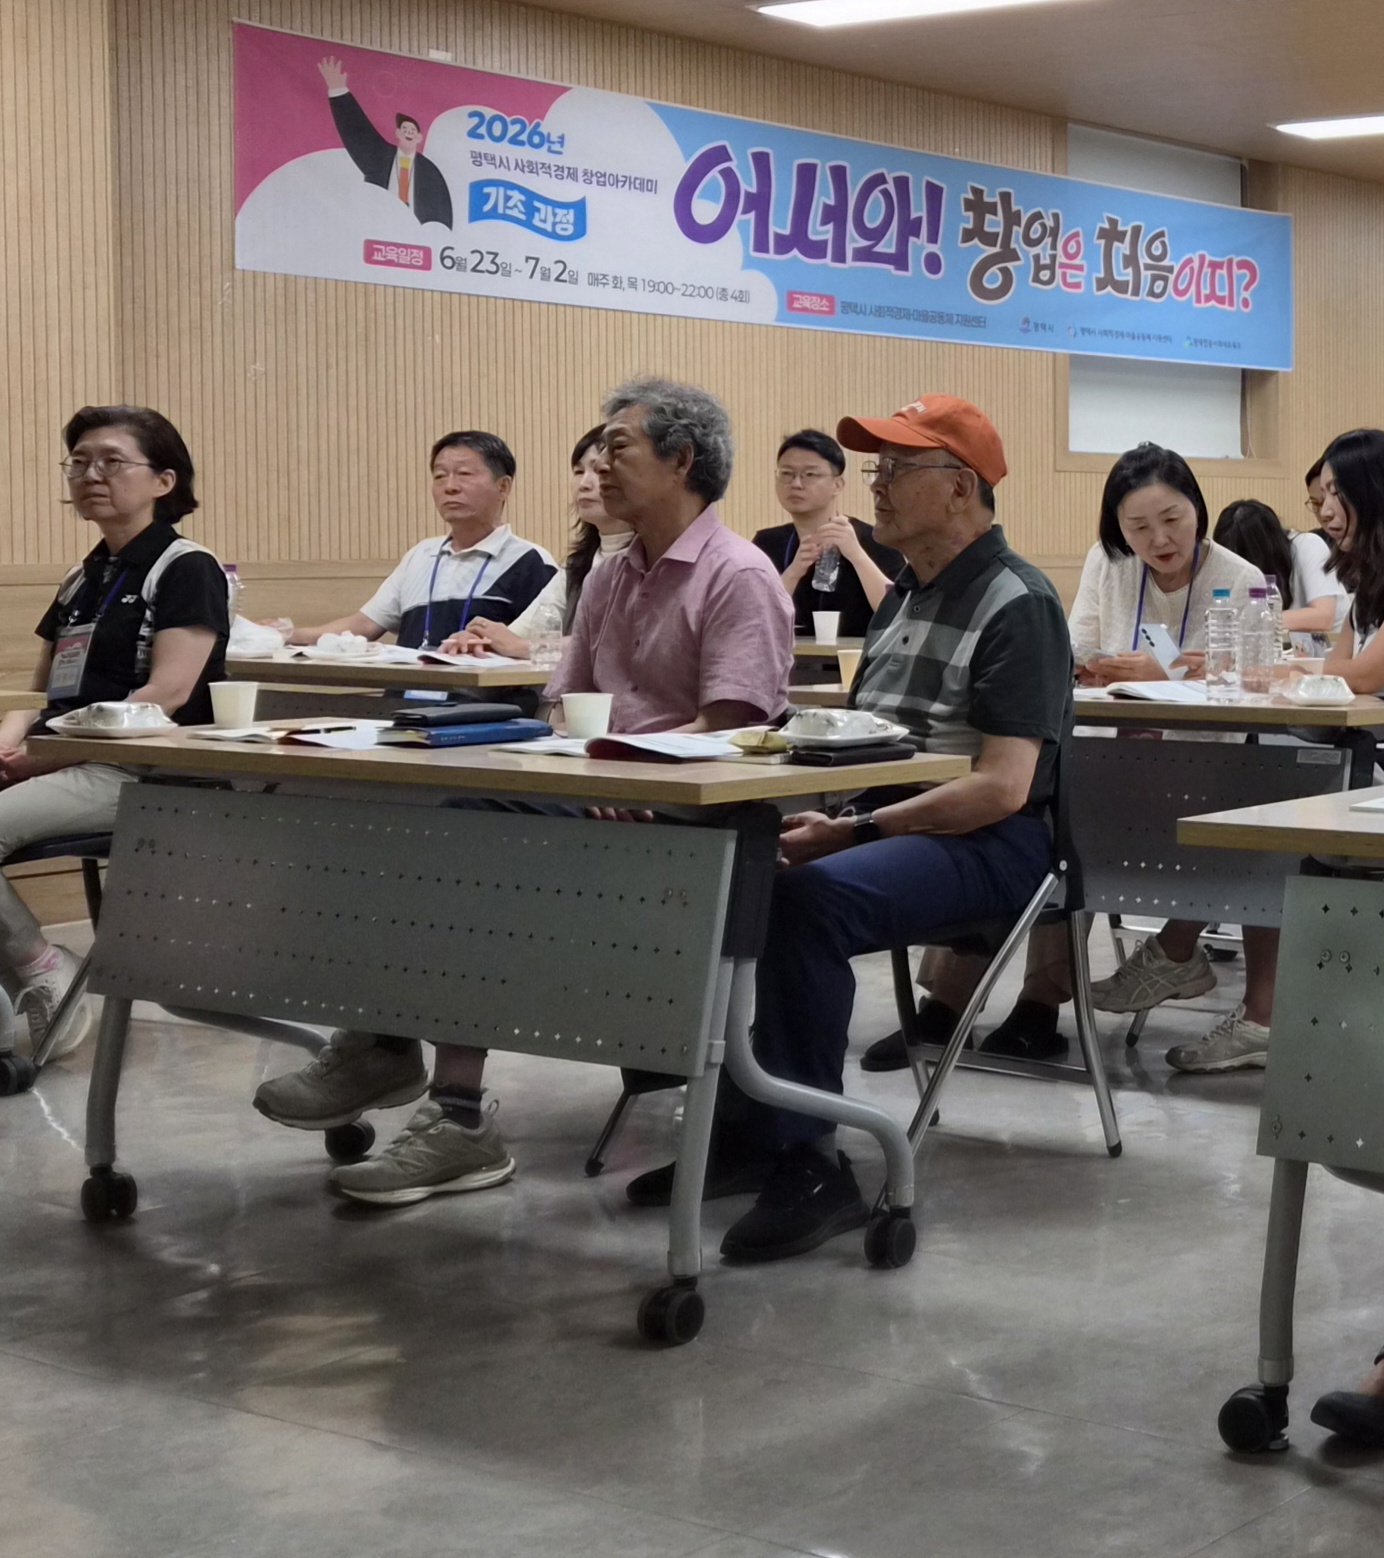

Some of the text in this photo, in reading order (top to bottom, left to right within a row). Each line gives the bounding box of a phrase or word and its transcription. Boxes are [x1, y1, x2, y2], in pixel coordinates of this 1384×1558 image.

[467, 111, 565, 155] 2026년
[469, 150, 658, 194] 평택시 사회적경제 창업아카데미
[482, 187, 575, 236] 기초 과정
[673, 143, 1258, 310] 어서와! 창업은 처음이지?
[372, 244, 424, 266] 교육일정
[439, 246, 467, 272] 6월
[470, 249, 512, 277] 23일
[525, 256, 551, 282] 7월
[553, 260, 579, 285] 2일
[641, 278, 714, 299] 19:00~22:00
[791, 293, 830, 311] 교육장소
